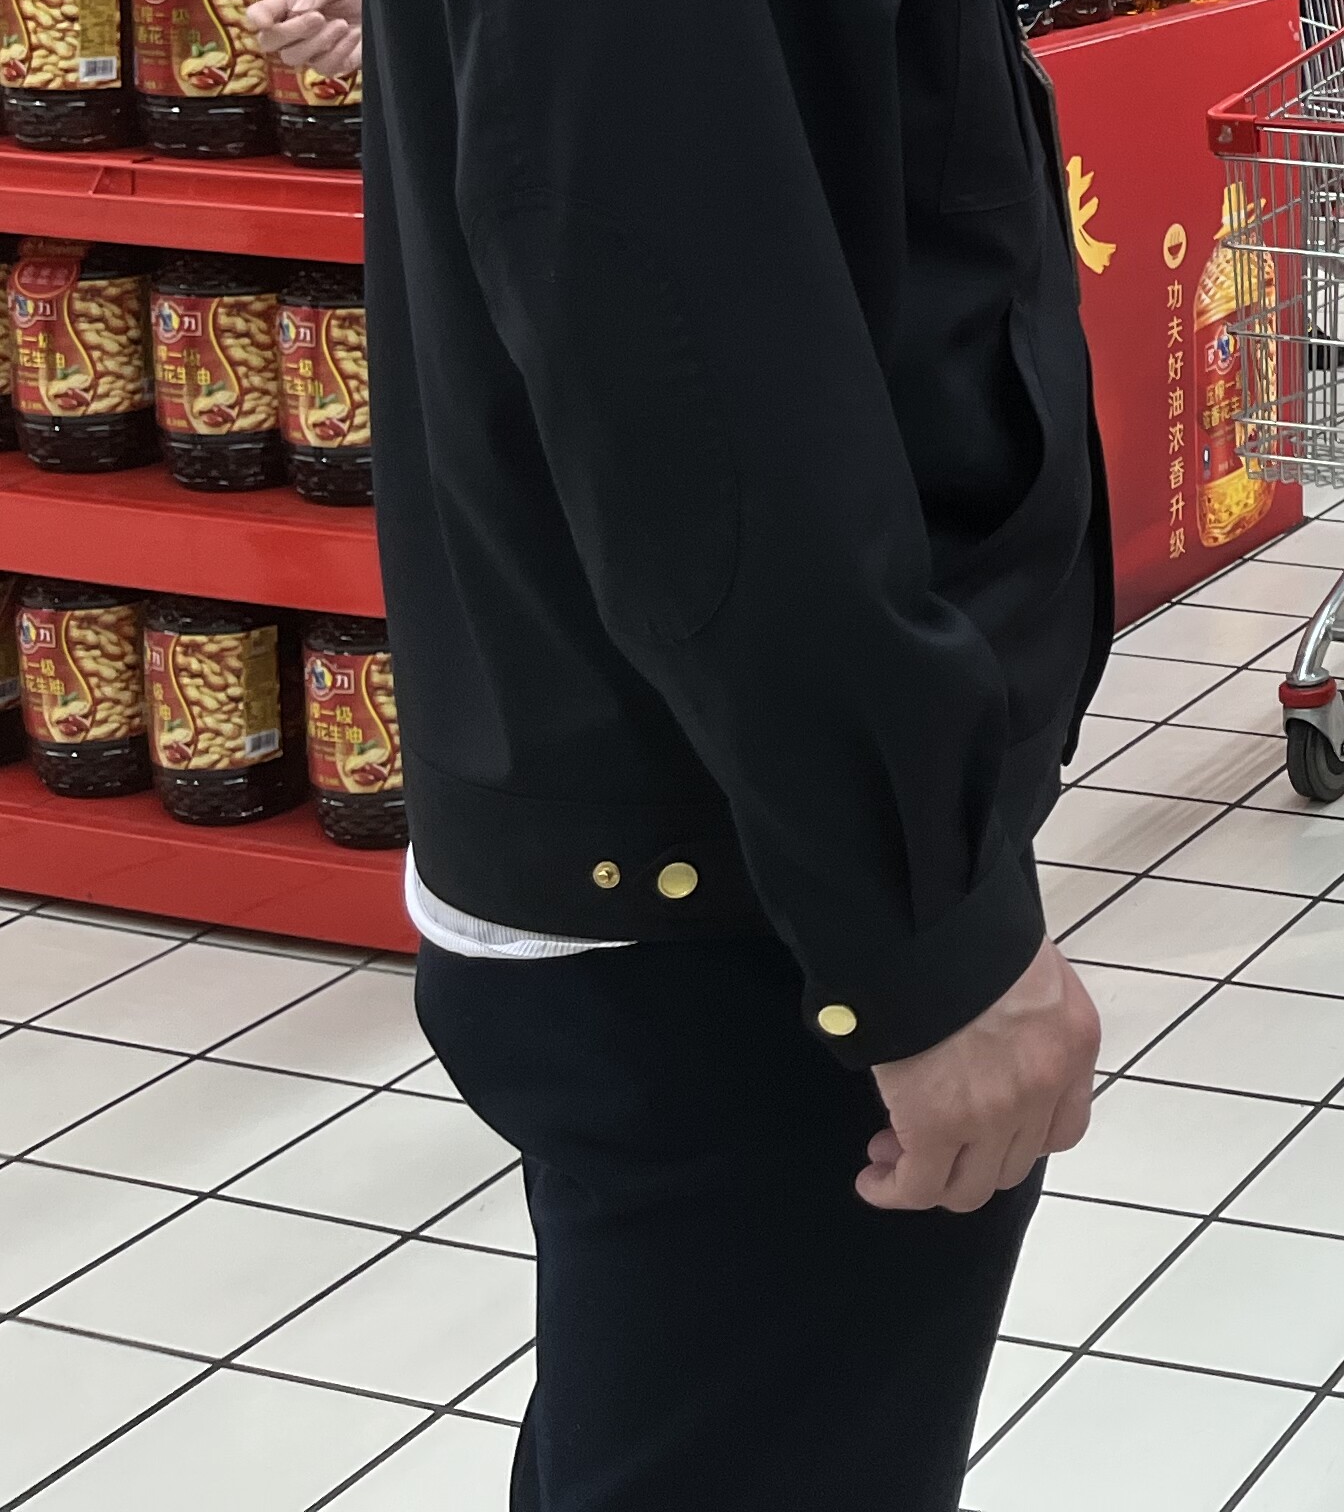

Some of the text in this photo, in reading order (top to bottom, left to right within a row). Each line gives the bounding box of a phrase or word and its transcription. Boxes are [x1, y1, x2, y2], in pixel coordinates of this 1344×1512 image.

[1167, 279, 1186, 559] 功夫好油浓香升级
